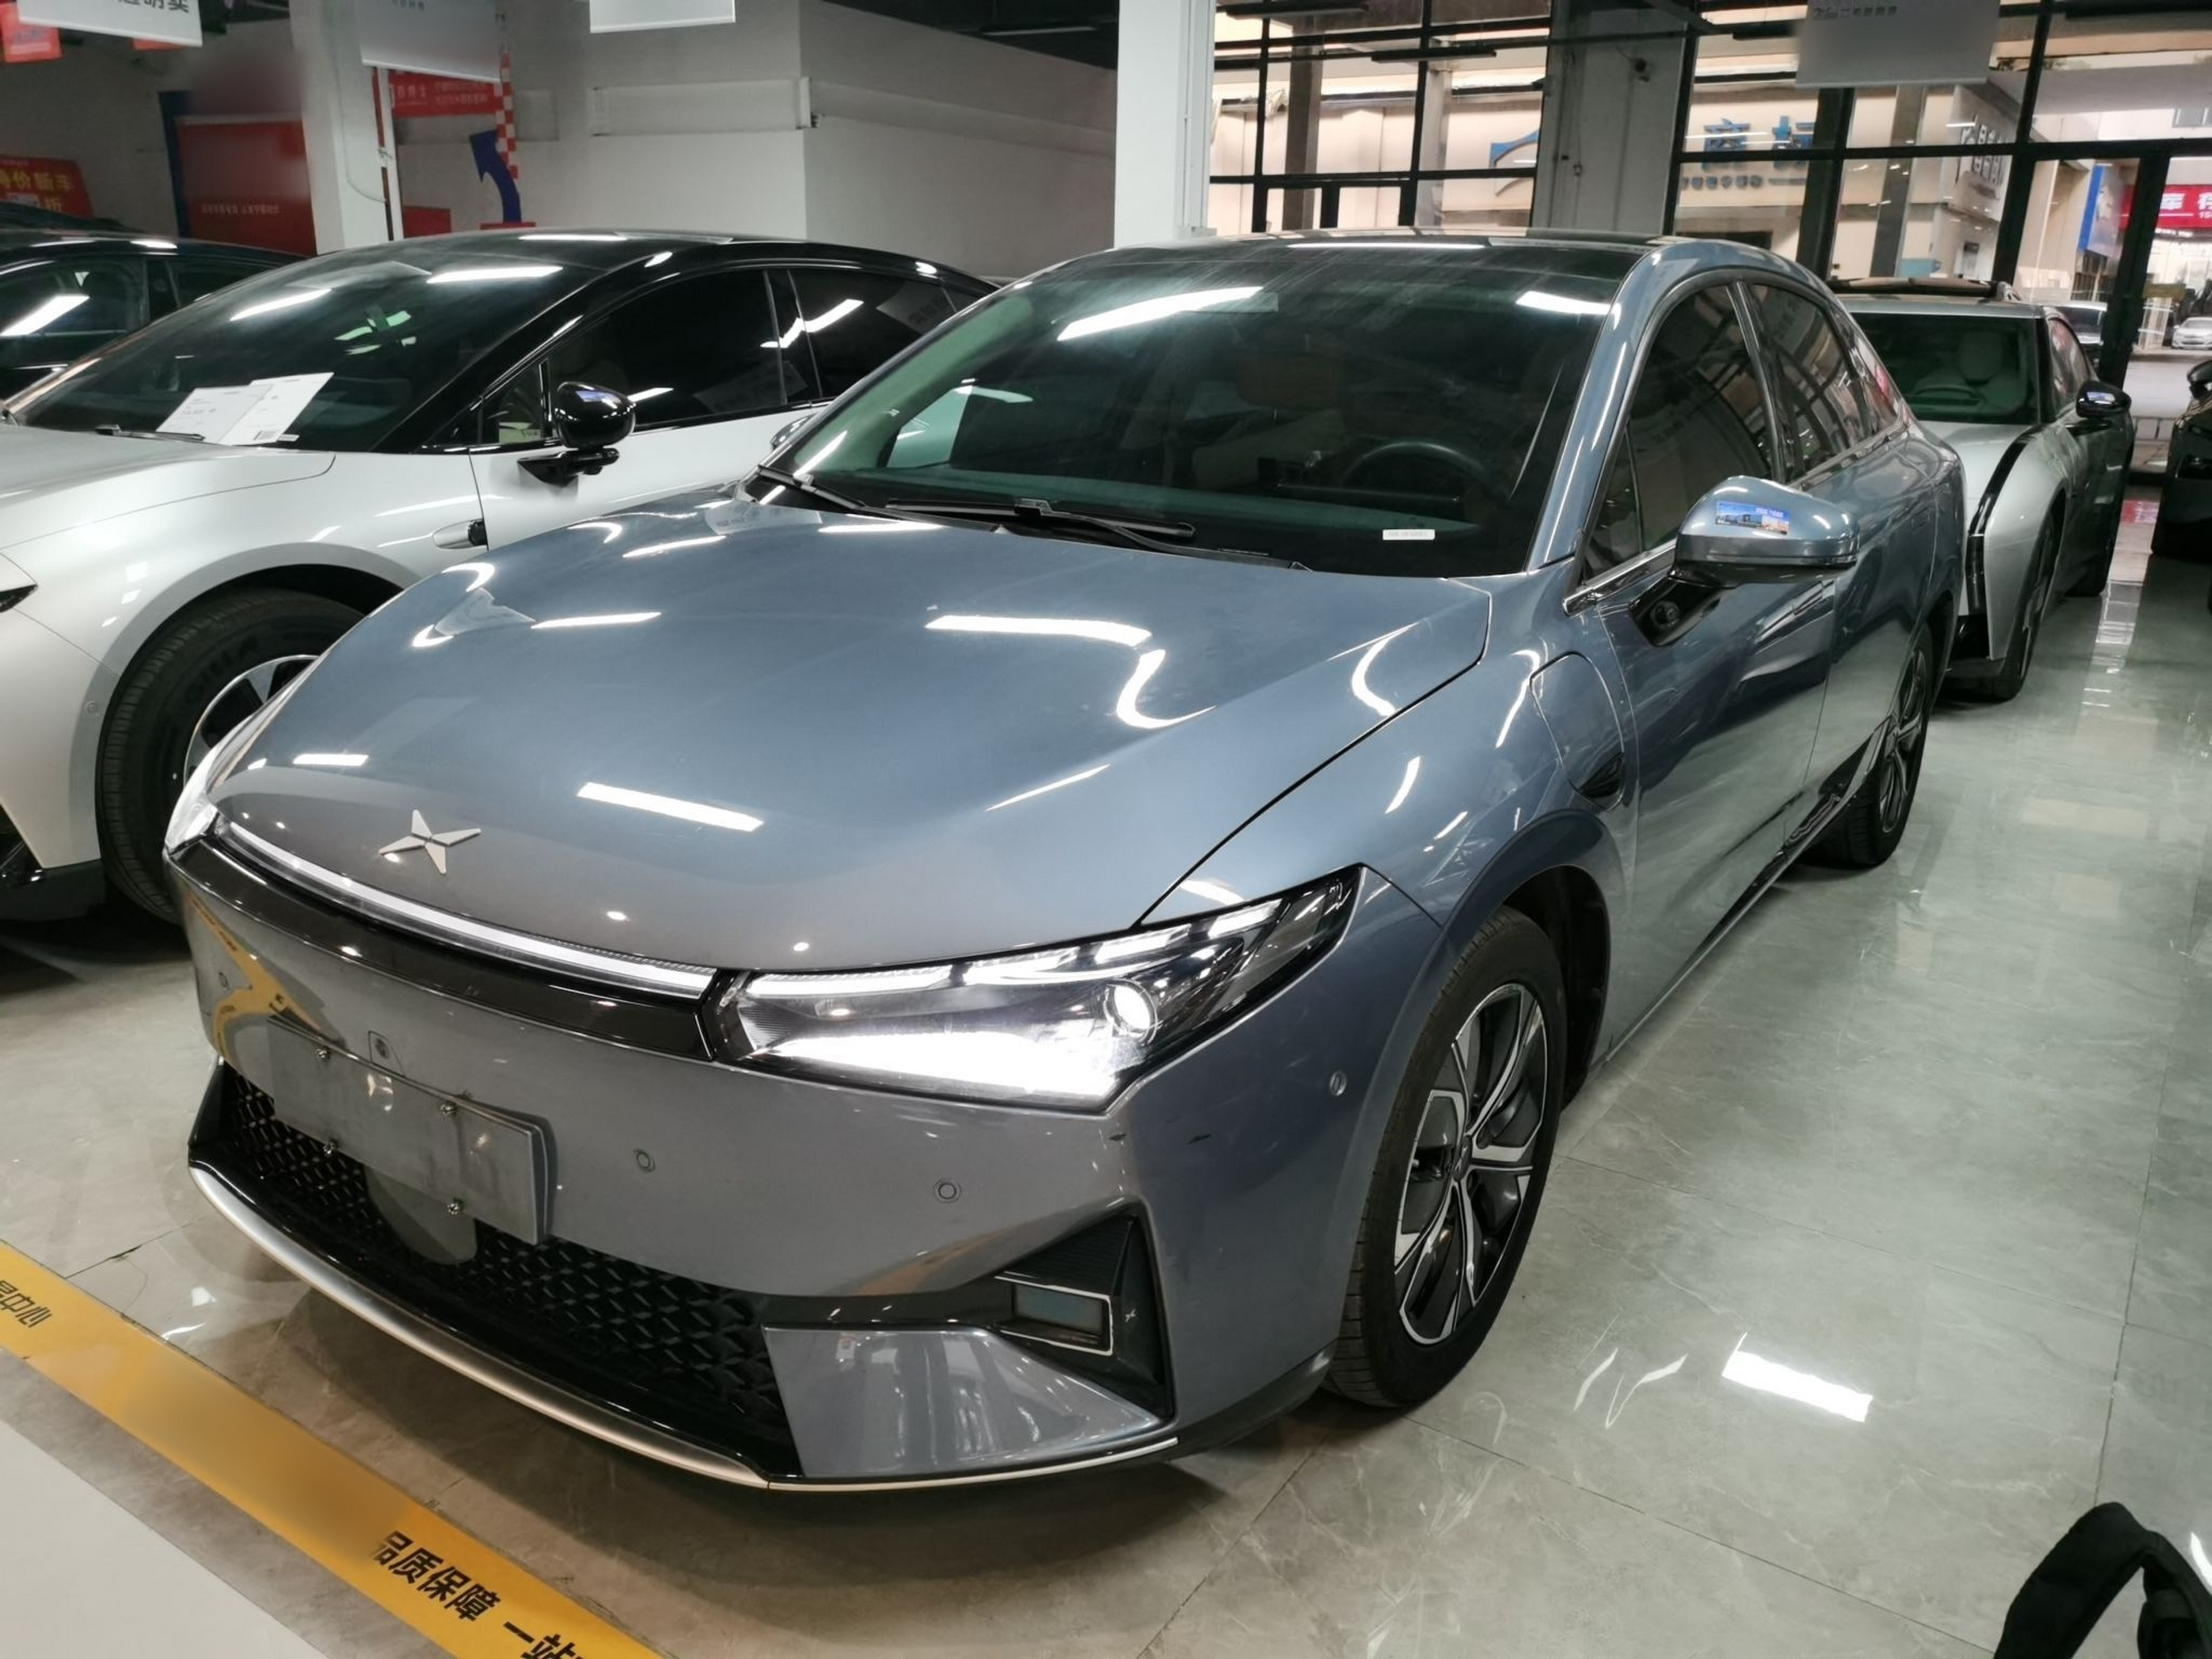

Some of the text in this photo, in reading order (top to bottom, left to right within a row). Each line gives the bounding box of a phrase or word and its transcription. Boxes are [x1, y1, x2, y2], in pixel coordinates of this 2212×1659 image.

[373, 1530, 501, 1622] 品质保障
[503, 1621, 585, 1659] 一站
